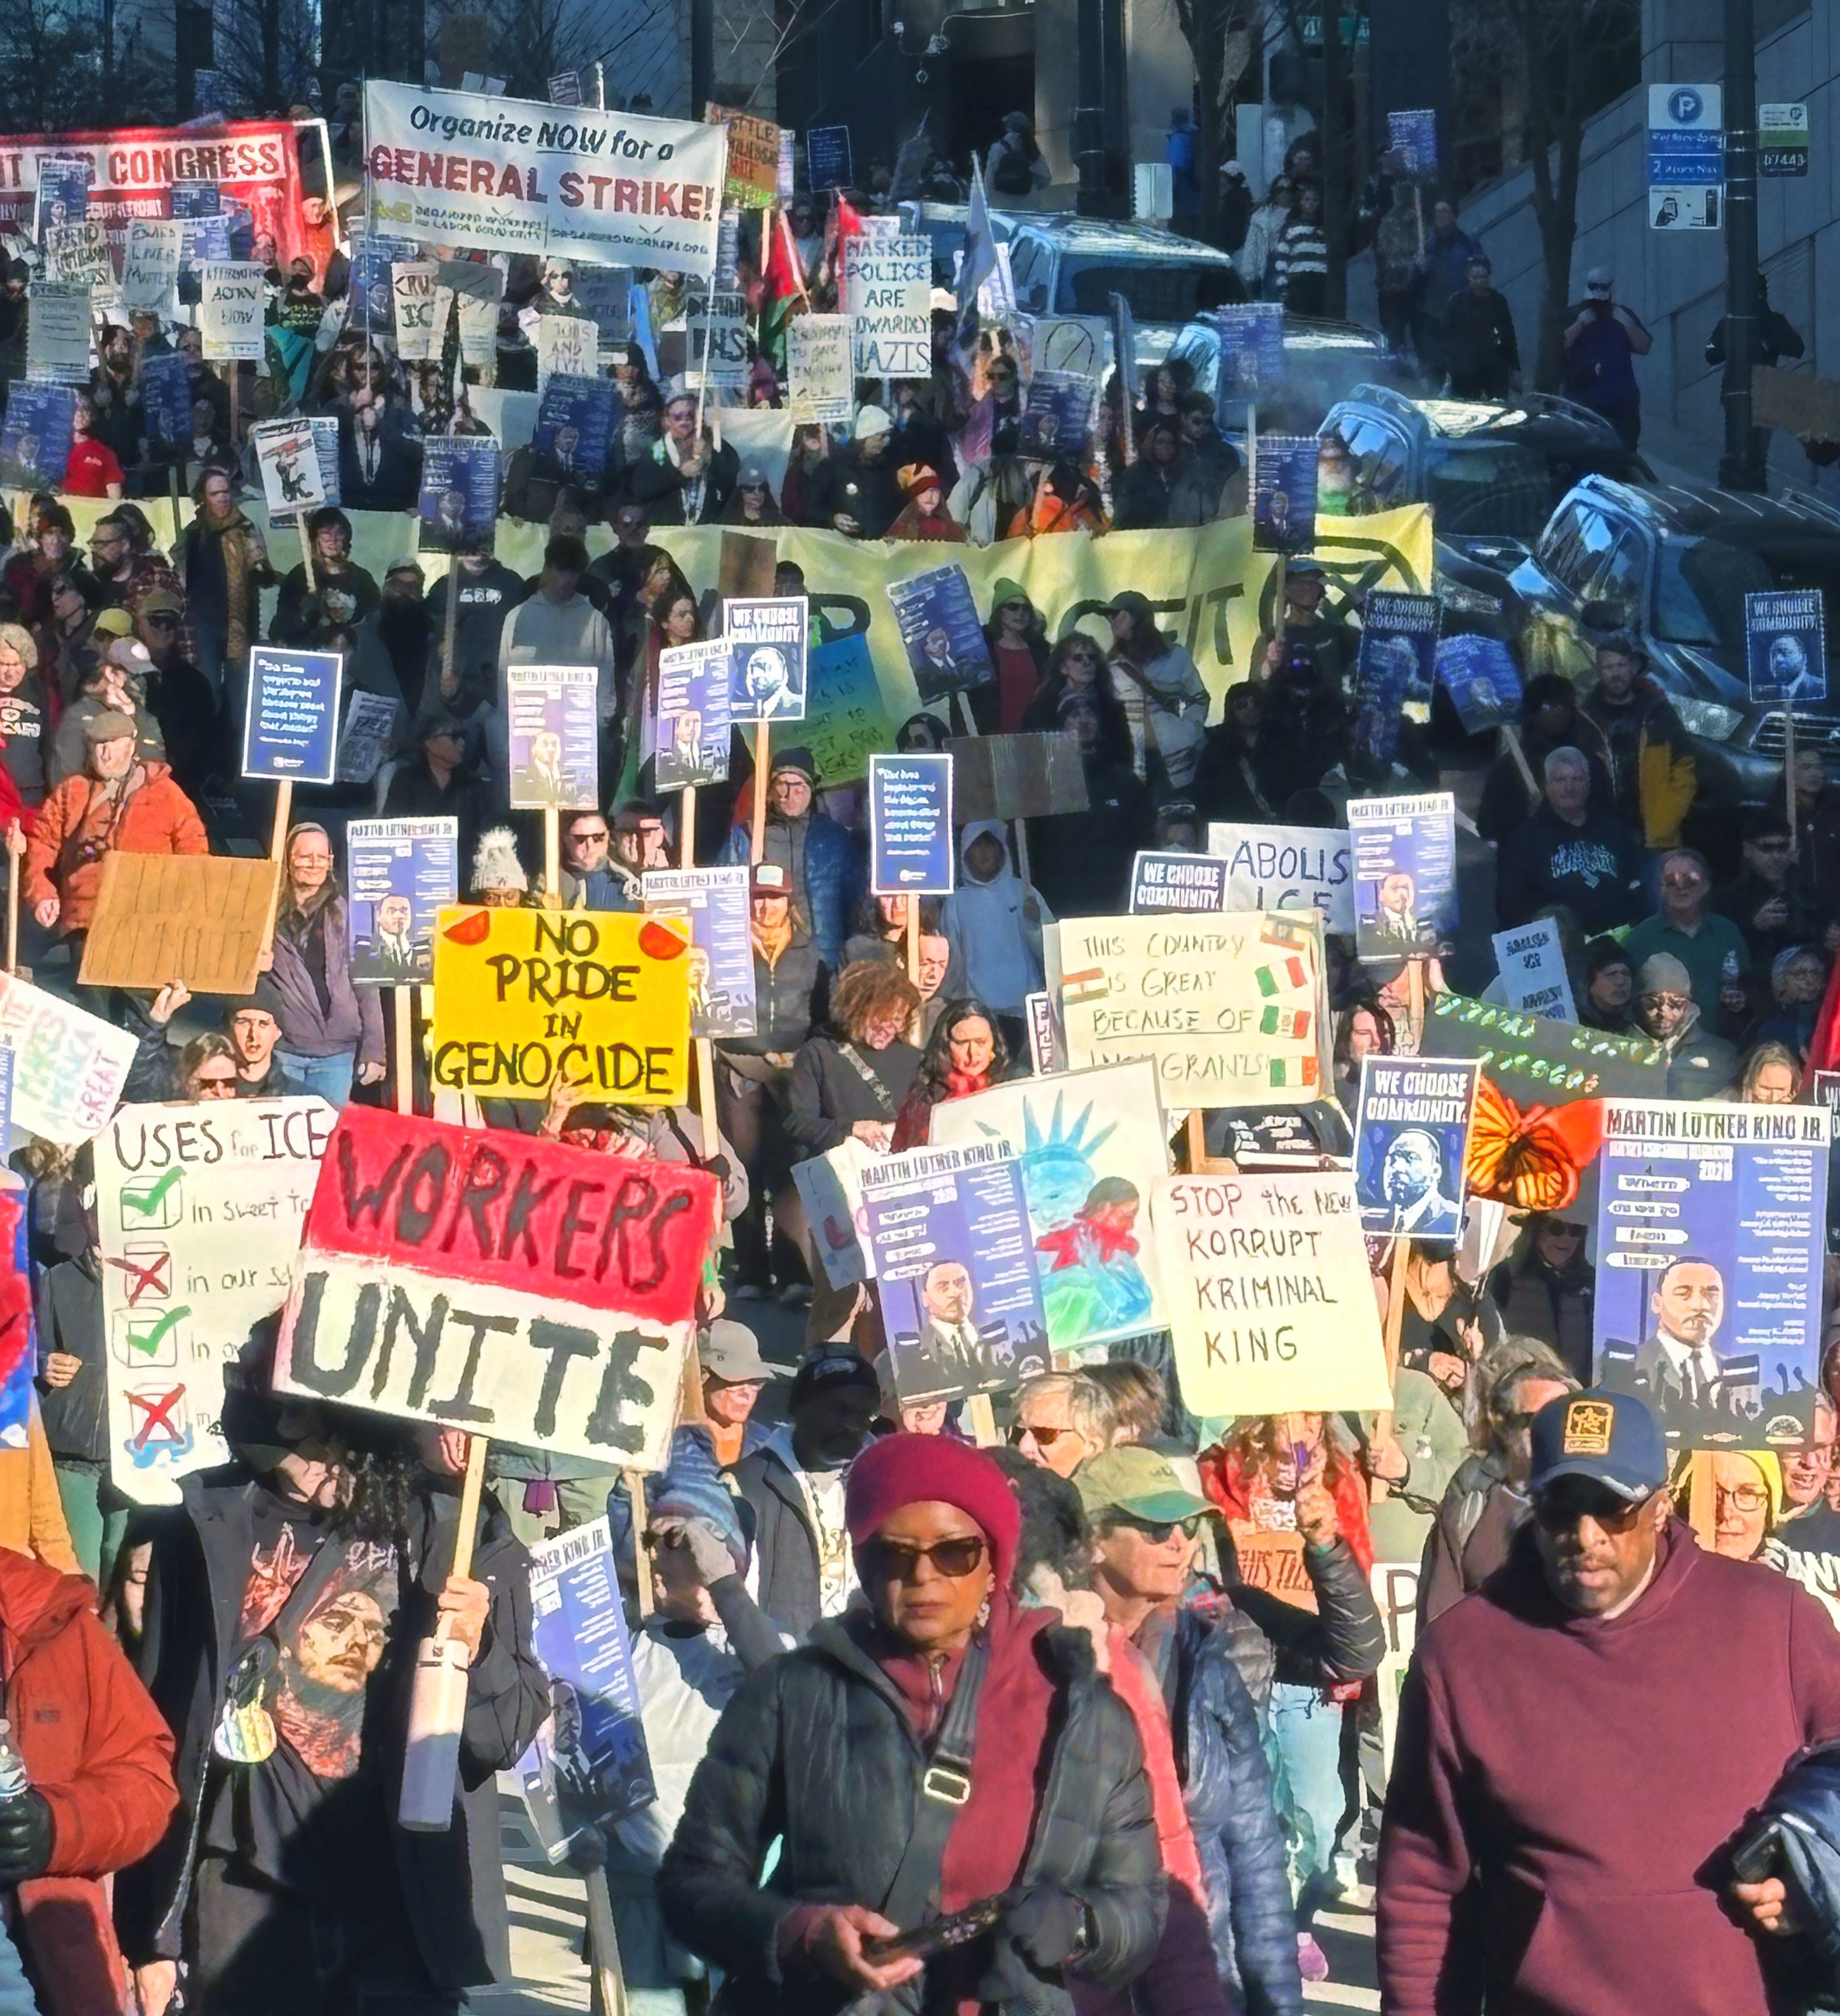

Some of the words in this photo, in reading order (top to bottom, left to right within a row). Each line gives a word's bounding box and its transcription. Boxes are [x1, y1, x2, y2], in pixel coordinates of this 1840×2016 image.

[410, 105, 532, 145] Organize
[537, 121, 607, 154] NOW
[611, 131, 652, 161] for
[657, 142, 674, 161] a
[109, 142, 281, 185] CONGRESS
[369, 144, 548, 204] GENERAL
[558, 170, 715, 222] STRIKE!
[847, 262, 931, 283] POLICE
[864, 288, 906, 308] ARE
[1144, 862, 1166, 884] WE
[1167, 864, 1220, 887] CHOOSE
[1230, 840, 1350, 884] ABOLIS
[535, 913, 599, 956] NO
[1083, 935, 1126, 959] THIS
[1147, 933, 1245, 960] COUNTRY
[486, 956, 641, 1007] PRIDE
[1108, 971, 1126, 993] IS
[1141, 968, 1217, 997] GREAT
[544, 1012, 582, 1040] IN
[1093, 1009, 1200, 1034] BECAUSE
[1217, 1008, 1255, 1033] OF
[434, 1041, 674, 1095] GENOCIDE
[1374, 1069, 1402, 1095] WE
[1403, 1071, 1469, 1098] CHOOSE
[73, 1049, 121, 1130] GREAT
[1366, 1097, 1467, 1123] COMMUNITY.
[1607, 1108, 1677, 1138] MARTIN
[1681, 1110, 1748, 1140] LUTHER
[1753, 1114, 1796, 1141] KING
[113, 1119, 223, 1172] USES
[258, 1108, 329, 1160] ICE
[861, 1158, 911, 1188] MARTIN
[912, 1149, 962, 1180] LUTHER
[963, 1143, 996, 1170] KING
[336, 1128, 694, 1294] WORKERS
[1169, 1183, 1243, 1218] STOP
[1261, 1182, 1303, 1216] the
[1186, 1227, 1323, 1261] KORRUPT
[187, 1265, 210, 1294] in
[221, 1268, 258, 1290] our
[1194, 1275, 1339, 1310] KRIMINAL
[290, 1270, 669, 1455] UNITE
[1204, 1324, 1298, 1368] KING
